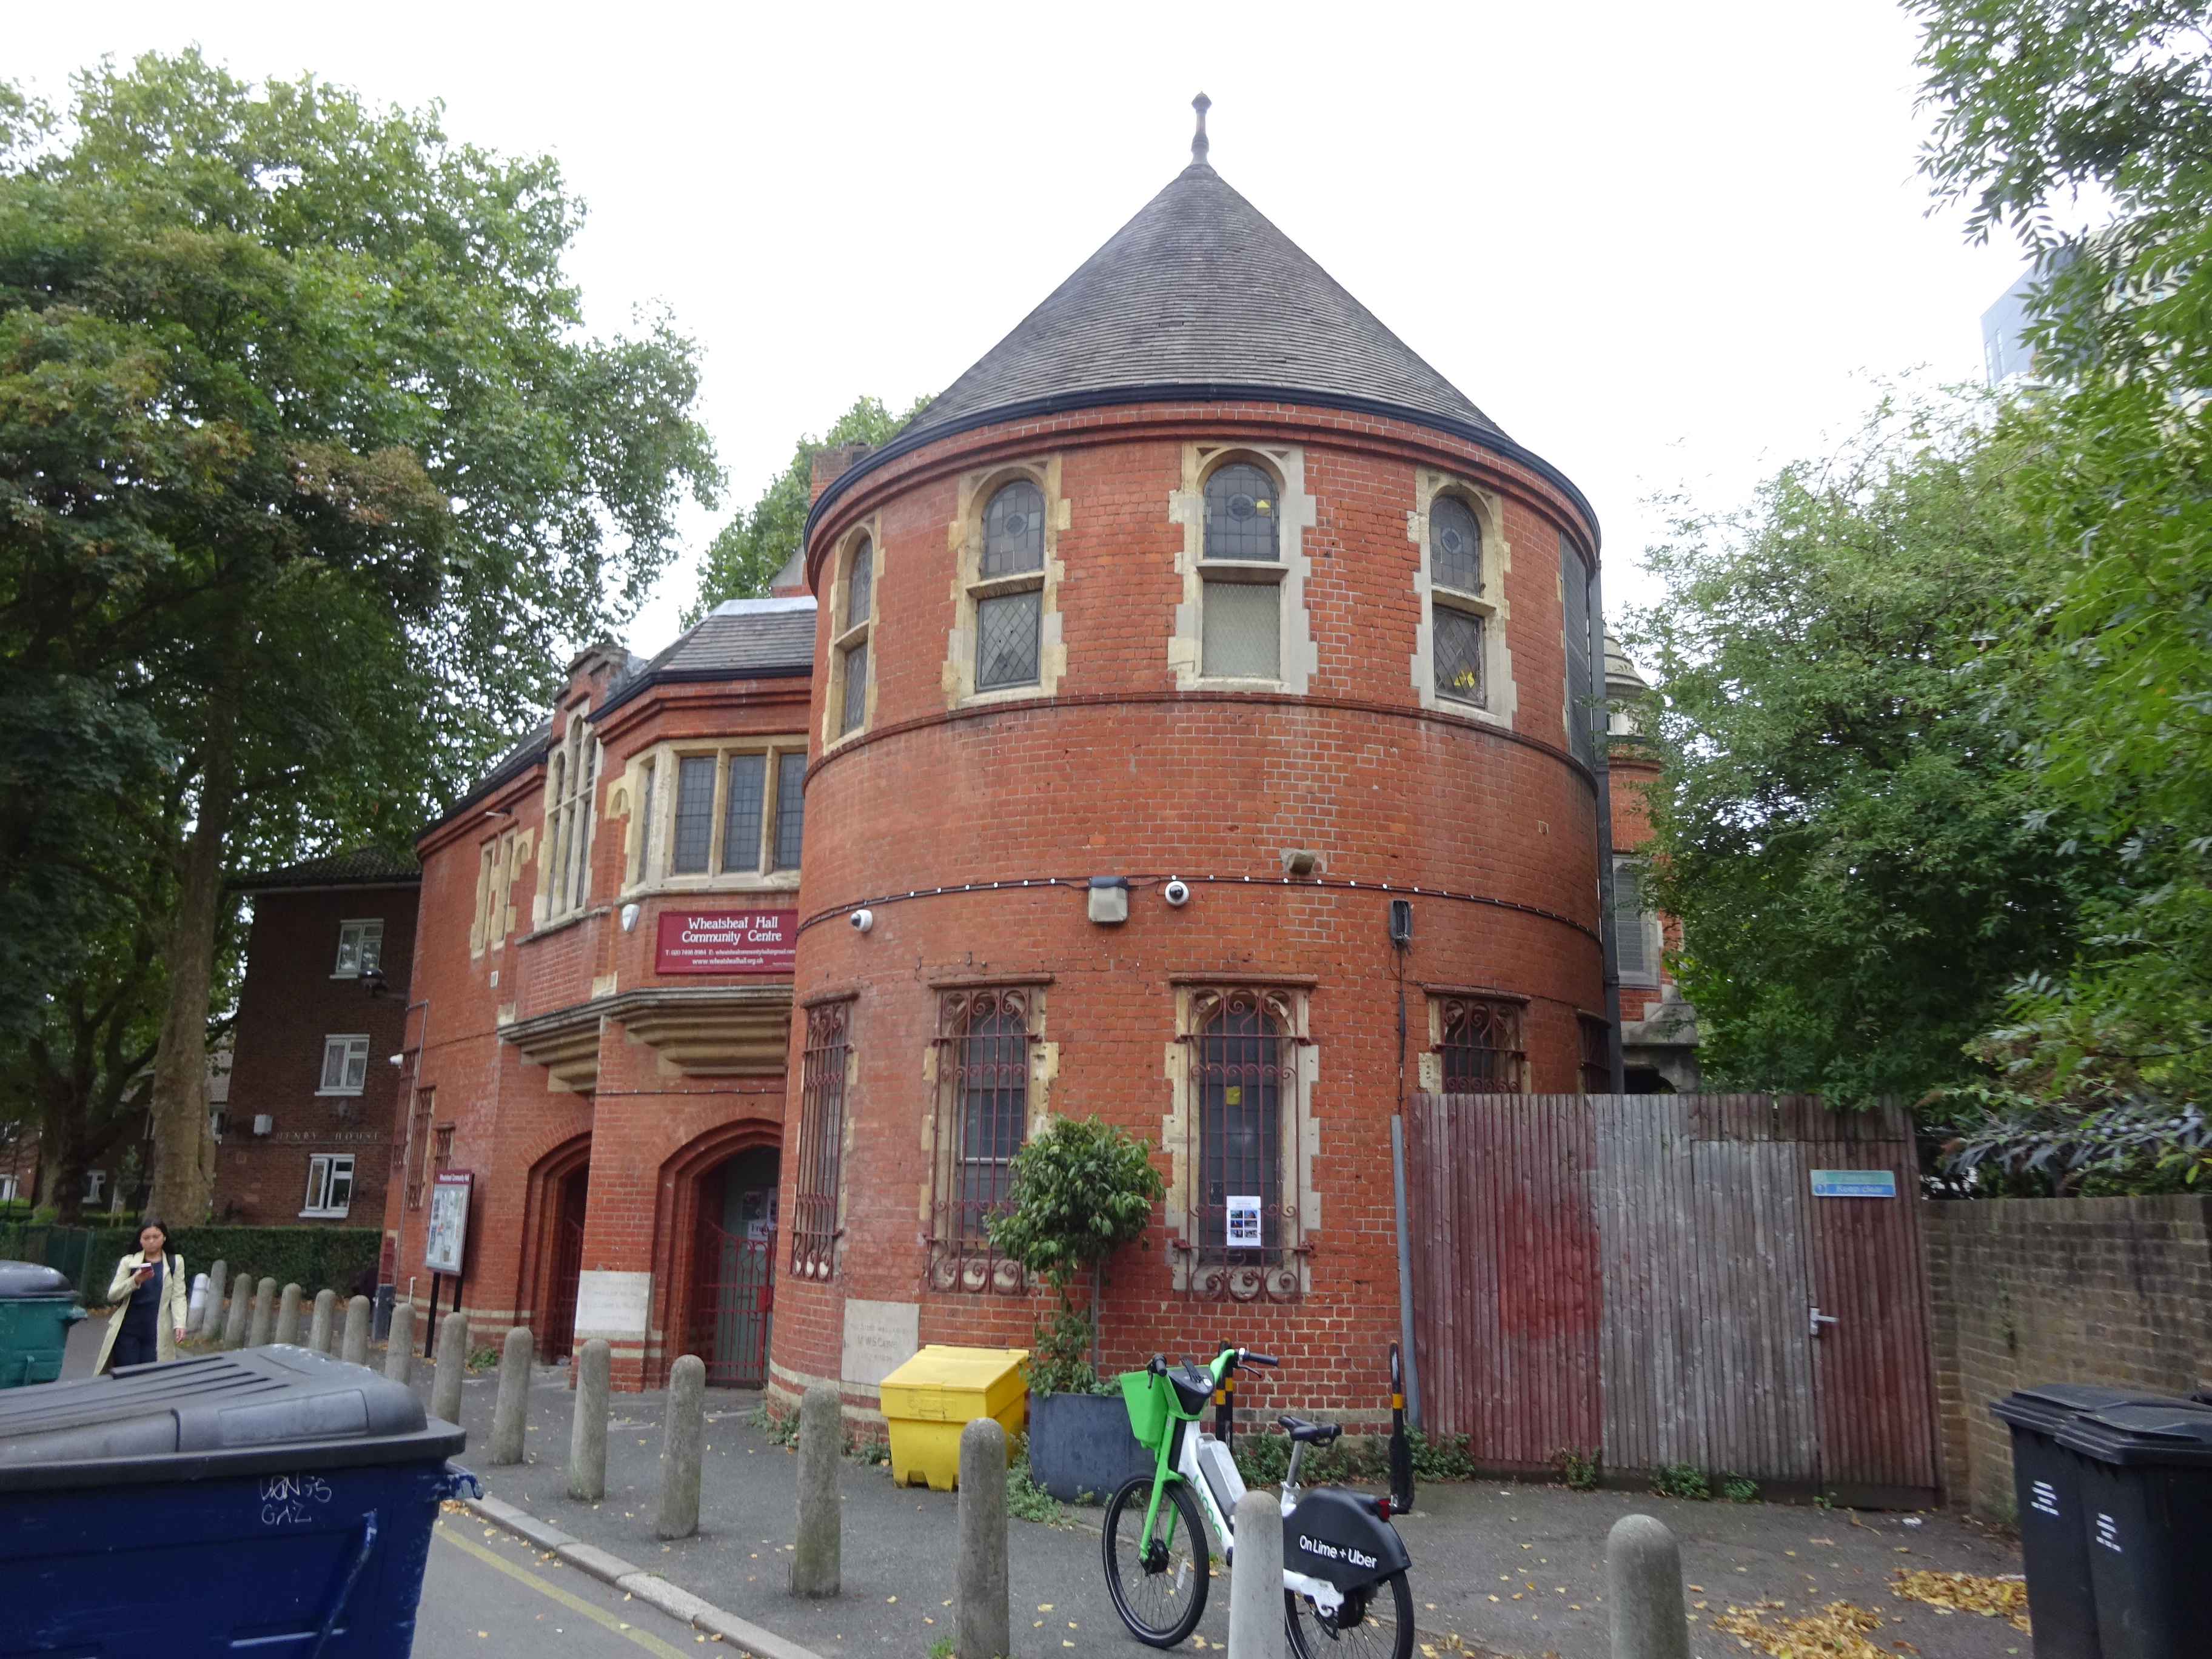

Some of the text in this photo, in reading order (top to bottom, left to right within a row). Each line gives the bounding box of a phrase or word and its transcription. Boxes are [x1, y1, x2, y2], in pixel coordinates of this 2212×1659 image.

[688, 916, 778, 930] Wheatsheaf Hall
[682, 930, 782, 946] Community Centre
[1299, 1535, 1378, 1569] On Lime + Uber
